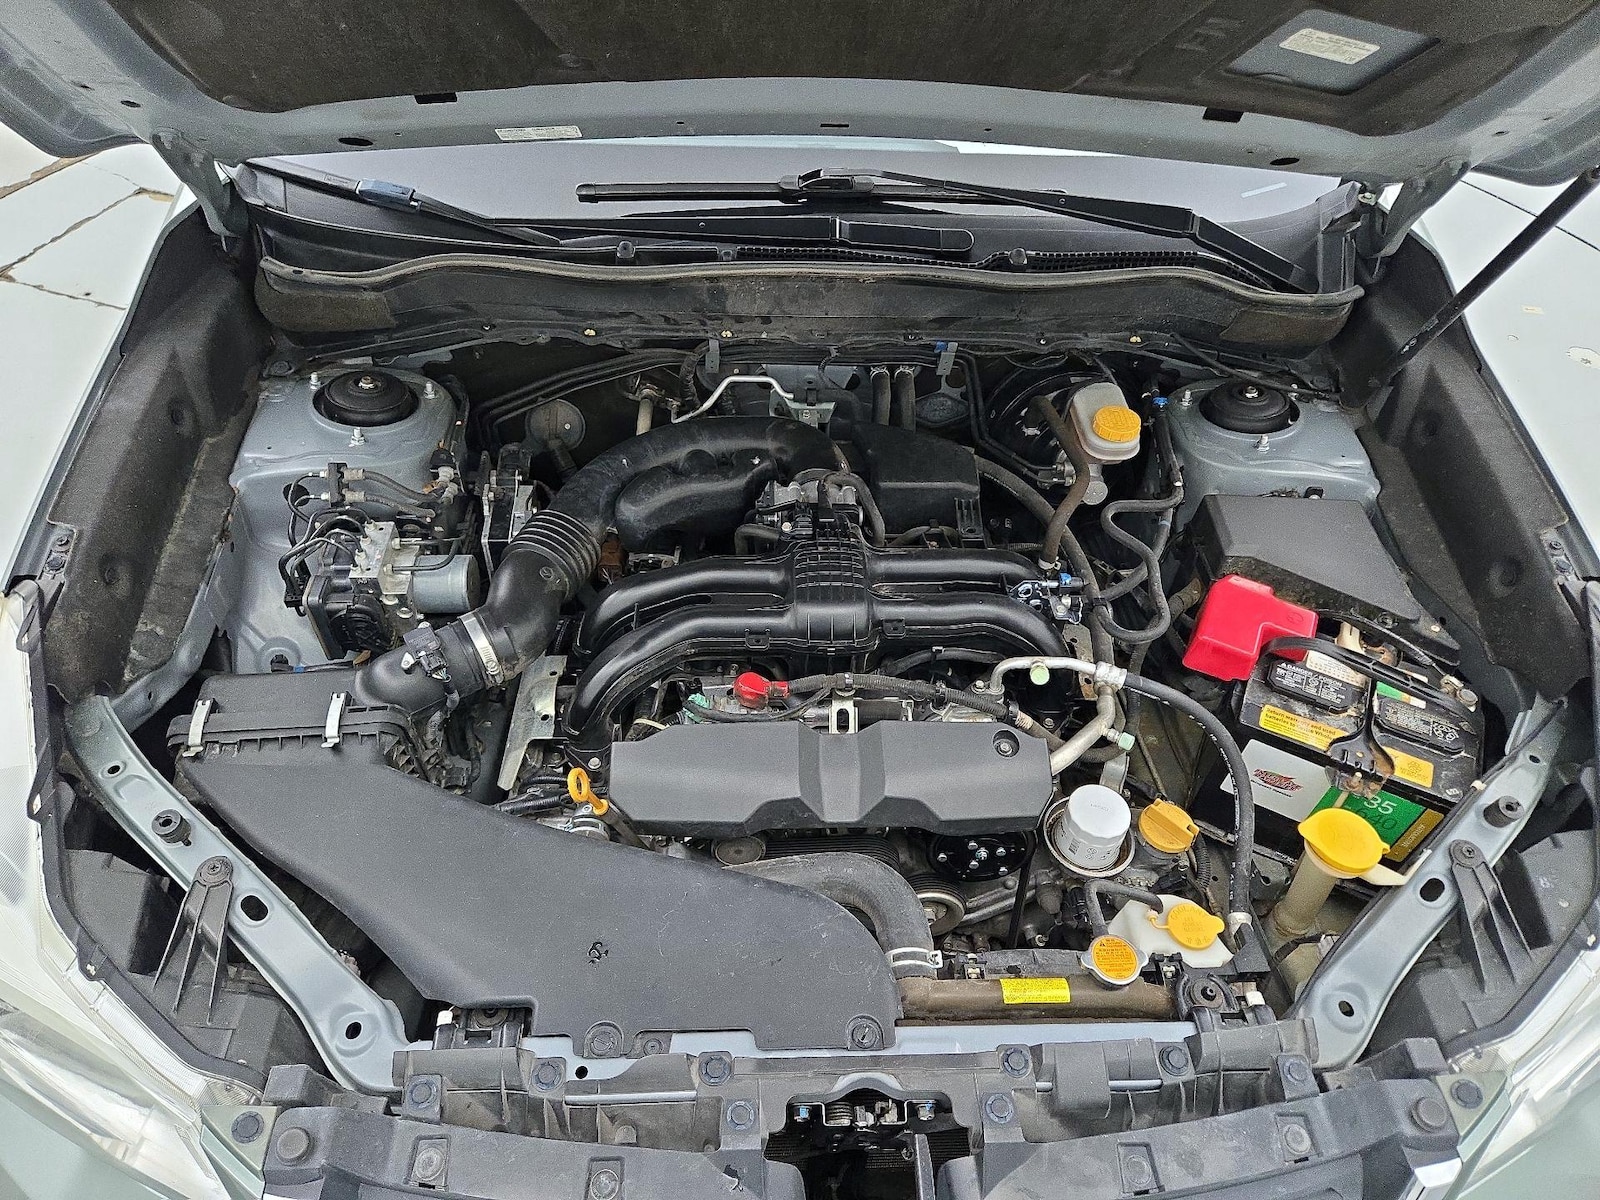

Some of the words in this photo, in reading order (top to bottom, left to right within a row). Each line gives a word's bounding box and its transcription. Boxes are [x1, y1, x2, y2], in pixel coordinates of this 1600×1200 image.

[1287, 664, 1314, 677] DANGER
[1364, 795, 1398, 814] 35
[1357, 808, 1398, 831] 640
